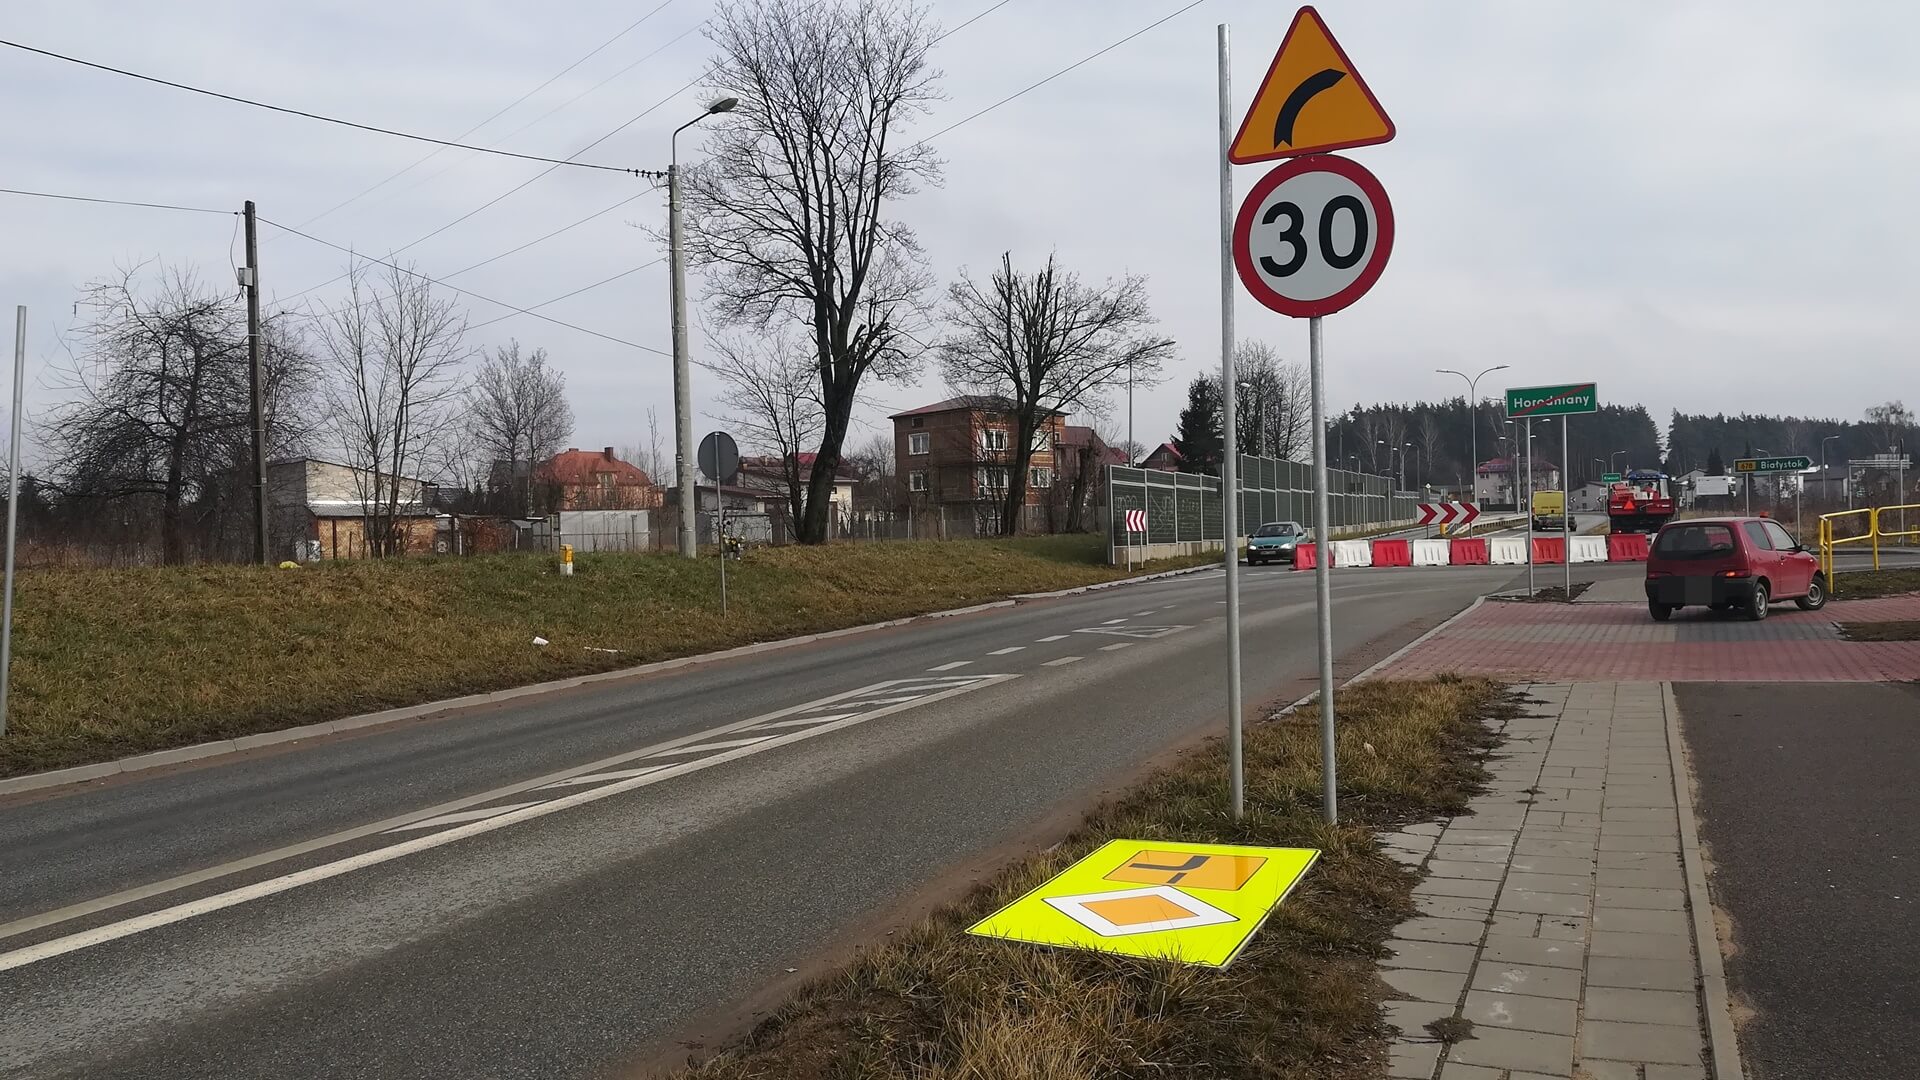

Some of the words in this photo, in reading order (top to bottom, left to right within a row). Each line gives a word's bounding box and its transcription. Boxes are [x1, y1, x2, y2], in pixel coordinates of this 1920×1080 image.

[1260, 195, 1368, 277] 30
[1513, 396, 1590, 409] Horodniany
[1761, 460, 1803, 470] Białystok
